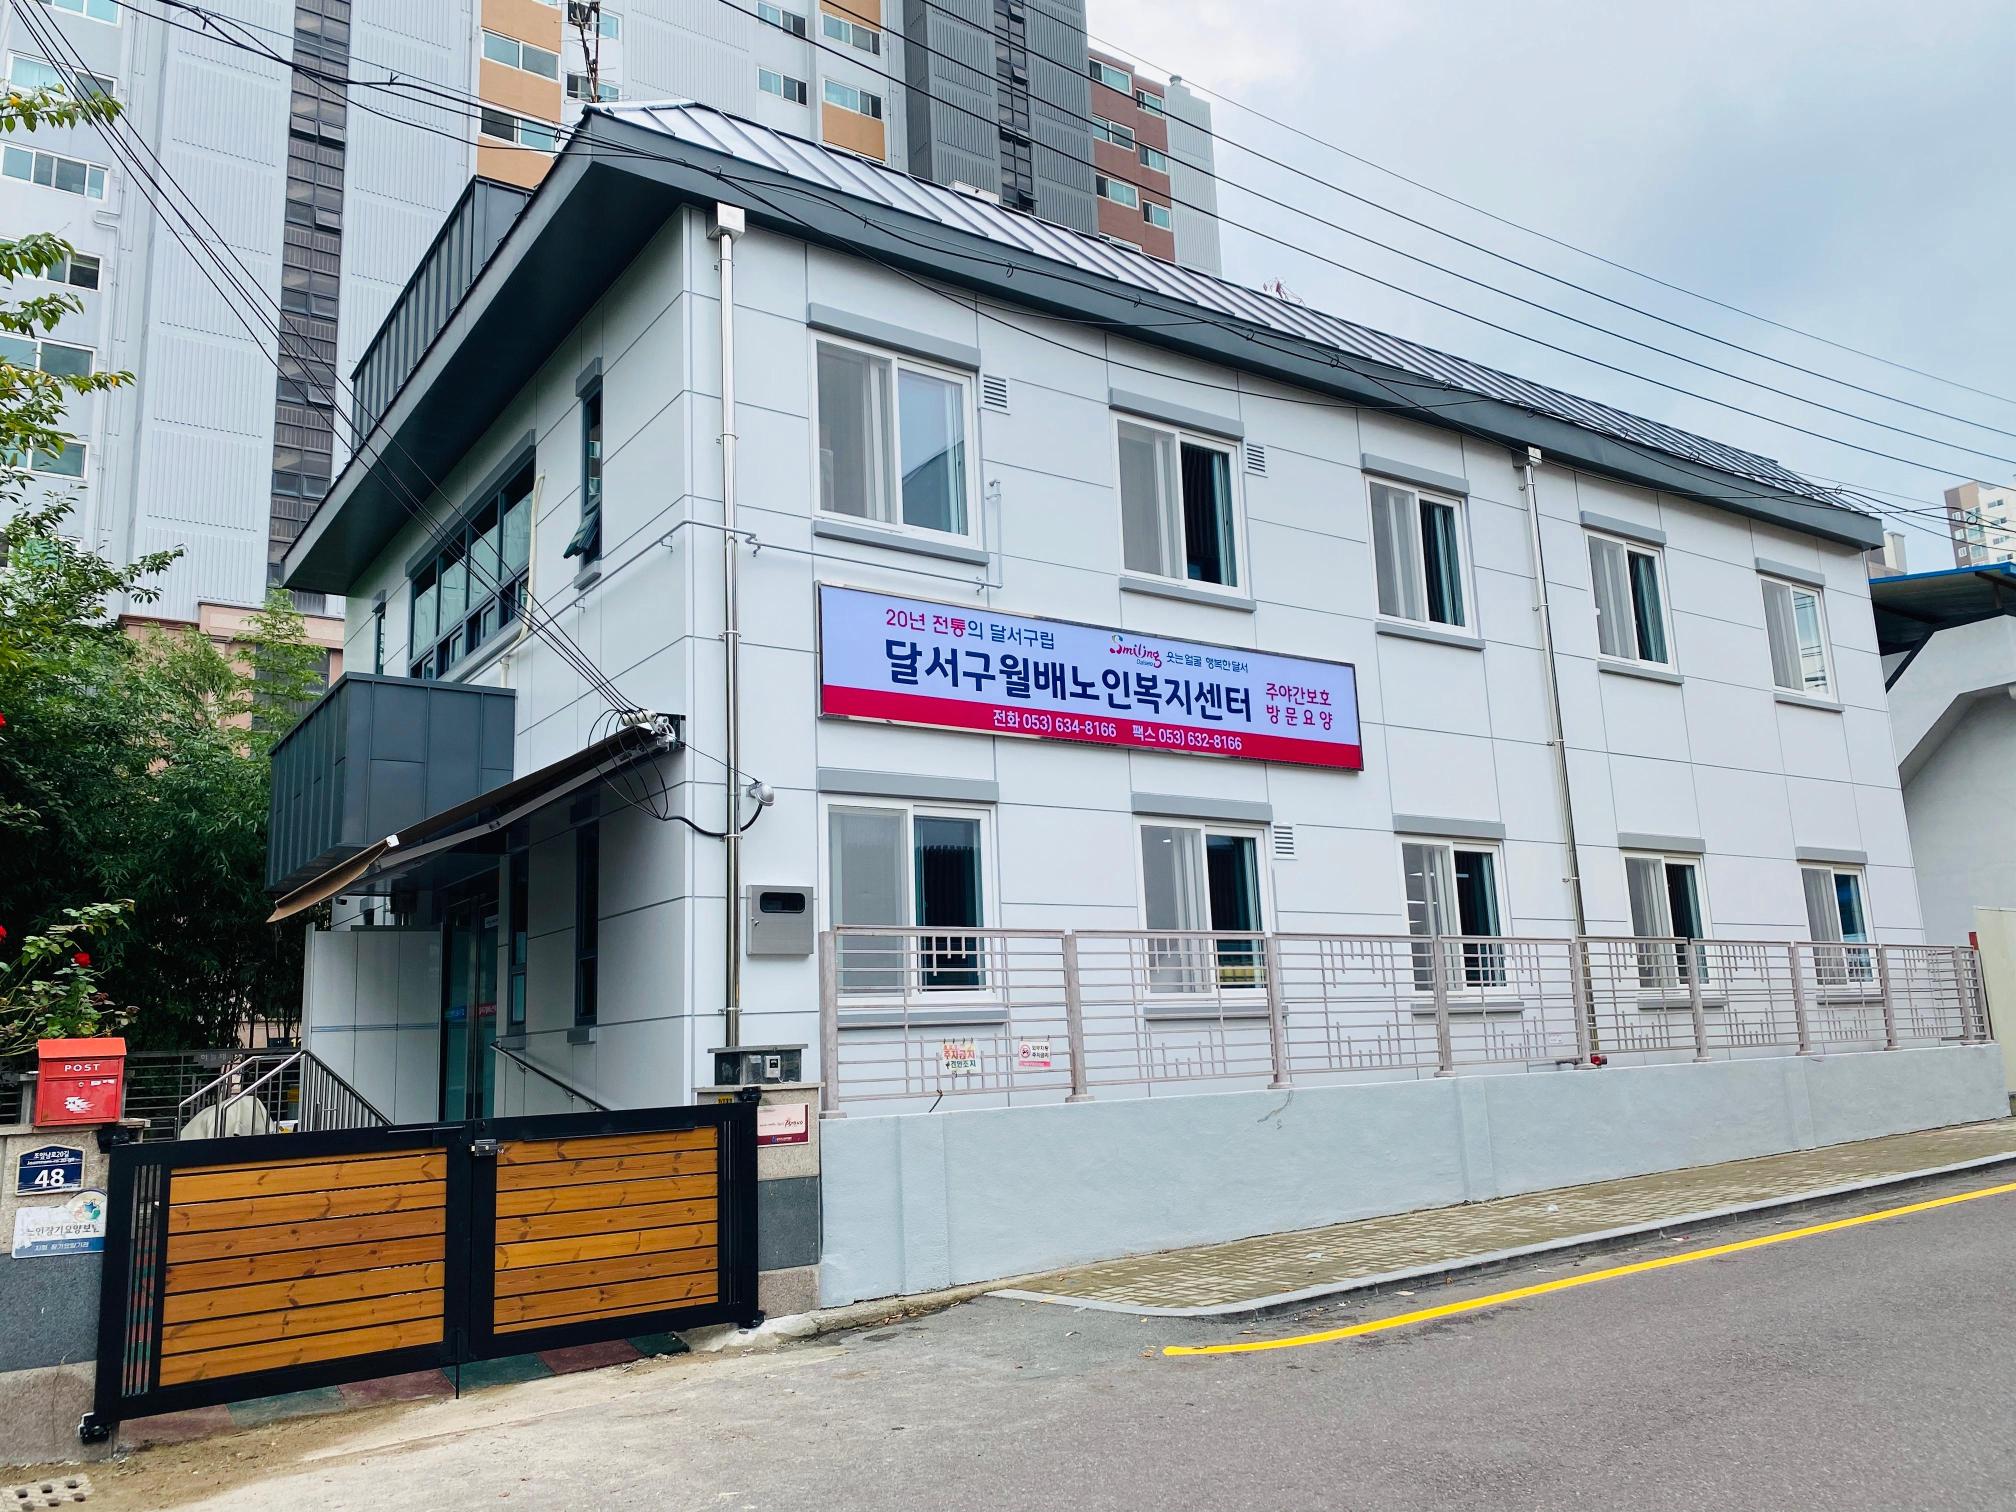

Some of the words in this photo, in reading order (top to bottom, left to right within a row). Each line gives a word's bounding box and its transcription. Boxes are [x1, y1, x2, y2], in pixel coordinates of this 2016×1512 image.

[886, 608, 925, 631] 20년
[932, 614, 983, 640] 전통의
[990, 623, 1055, 650] 달서구립
[885, 638, 1252, 723] 달서구월배노인복지센터
[1265, 682, 1332, 706] 주야간보호
[993, 709, 1020, 729] 전화
[1022, 713, 1052, 733] 053)
[1055, 717, 1117, 738] 634-8166
[1132, 724, 1156, 742] 팩스
[1158, 728, 1185, 747] 053)
[1187, 731, 1243, 751] 632-8166
[64, 1063, 101, 1073] POST
[34, 1168, 65, 1188] 48
